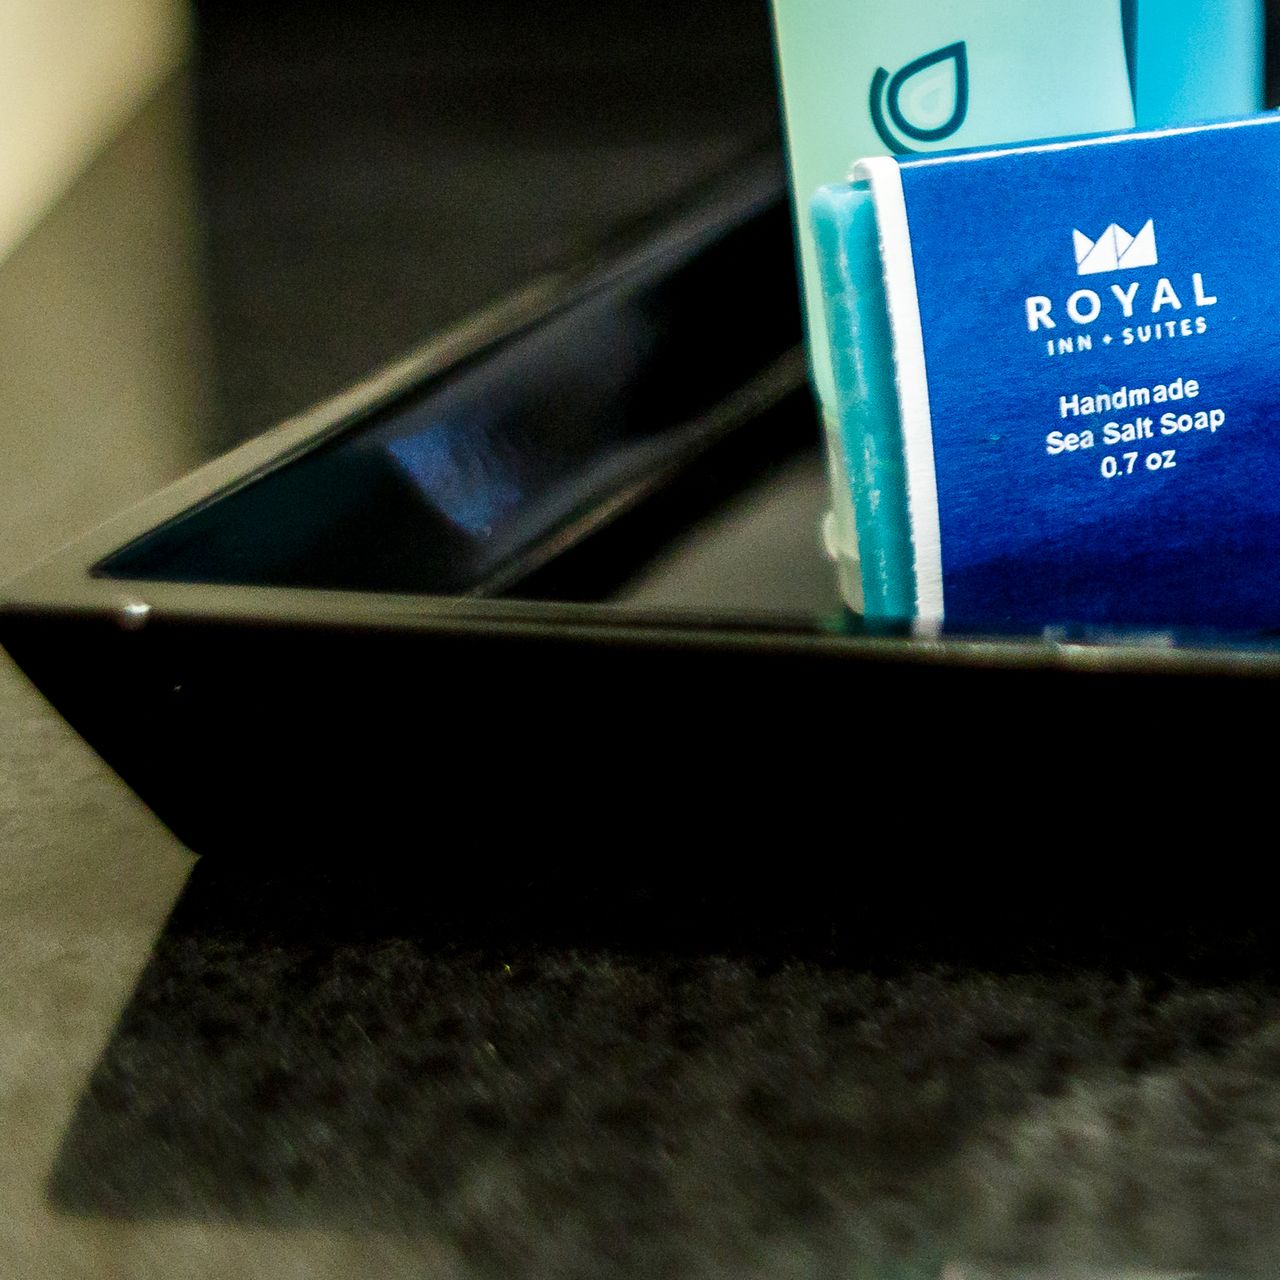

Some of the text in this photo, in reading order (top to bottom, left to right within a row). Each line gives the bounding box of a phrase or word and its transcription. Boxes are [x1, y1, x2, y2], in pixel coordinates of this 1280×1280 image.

[1026, 272, 1218, 332] ROYAL
[1046, 335, 1093, 357] INN
[1122, 316, 1208, 345] SUITES
[1058, 377, 1200, 418] Handmade
[1045, 407, 1227, 456] Sea Salt Soap
[1099, 450, 1177, 480] 0.7 oz
